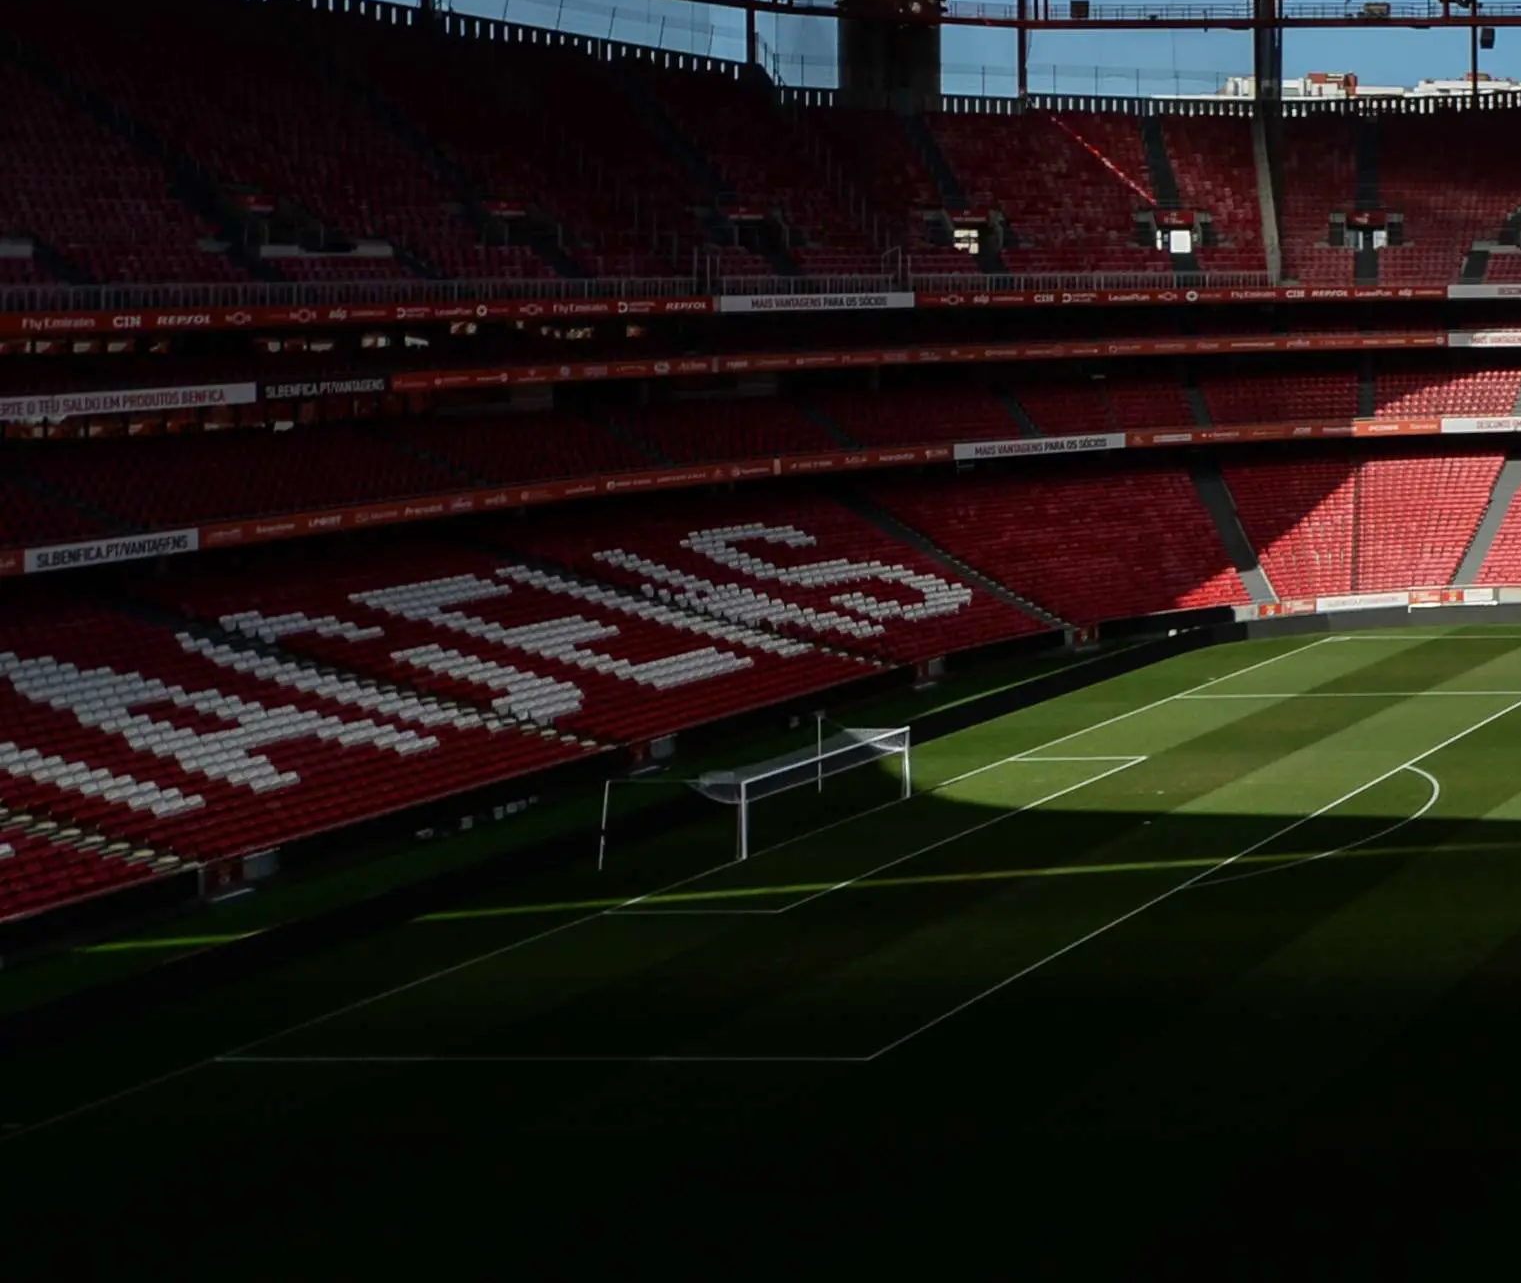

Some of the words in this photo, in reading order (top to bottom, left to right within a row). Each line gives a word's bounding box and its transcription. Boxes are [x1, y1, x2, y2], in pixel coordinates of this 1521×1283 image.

[664, 301, 707, 311] REPSOL
[751, 298, 773, 309] MAIS
[775, 297, 822, 308] VANTAGENS
[823, 297, 844, 307] PARA
[846, 296, 857, 307] OS
[112, 315, 142, 328] CIN
[156, 314, 211, 326] REPSOL
[62, 397, 101, 412] SALDO
[103, 396, 120, 409] EM
[122, 392, 180, 408] PRODUTOS
[181, 388, 226, 405] BENFICA
